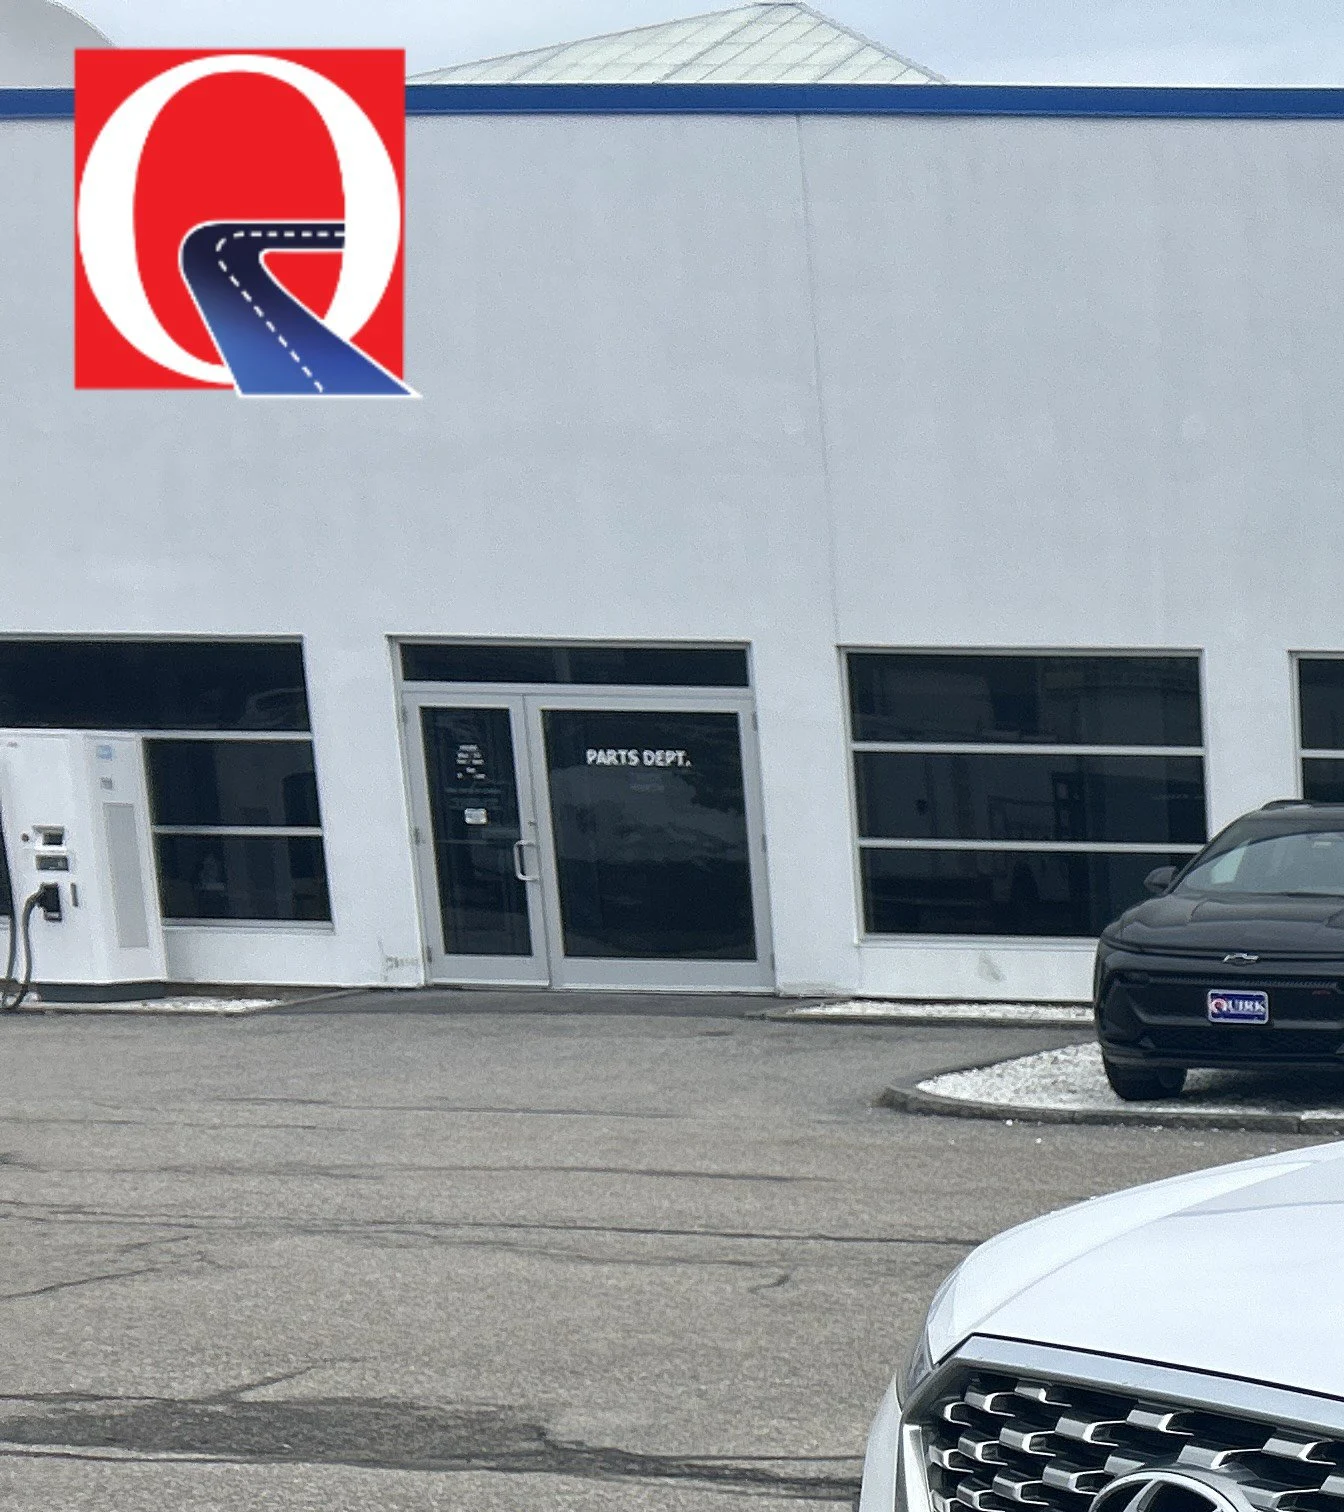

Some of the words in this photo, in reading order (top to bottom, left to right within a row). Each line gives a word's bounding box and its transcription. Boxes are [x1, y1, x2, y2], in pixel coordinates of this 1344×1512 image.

[586, 748, 640, 766] PARTS
[643, 749, 691, 767] DEPT.
[1211, 997, 1266, 1015] QUIRK
